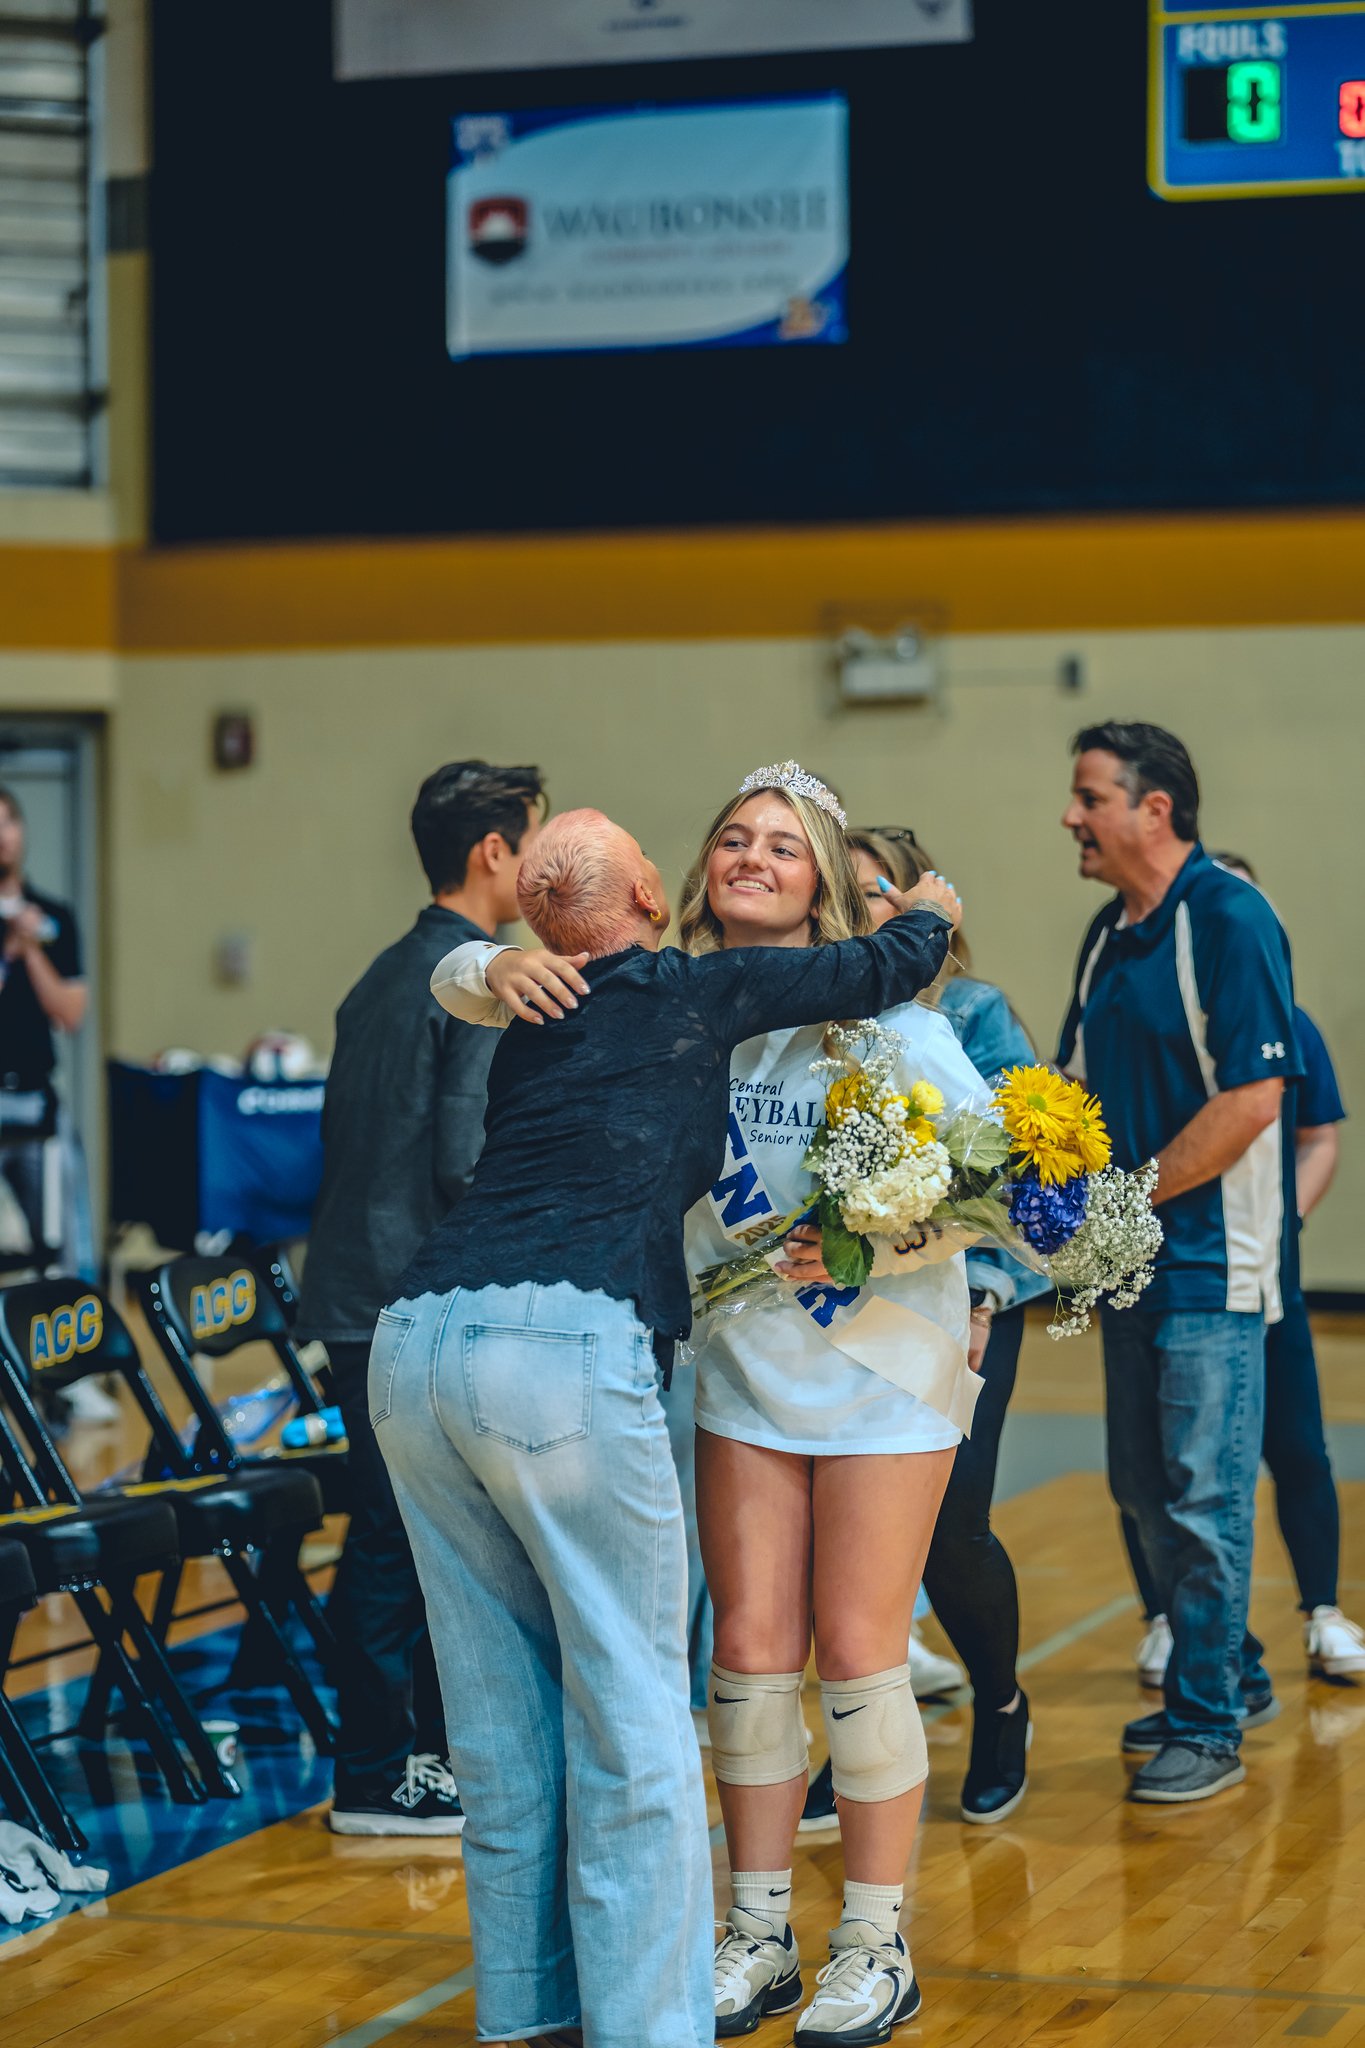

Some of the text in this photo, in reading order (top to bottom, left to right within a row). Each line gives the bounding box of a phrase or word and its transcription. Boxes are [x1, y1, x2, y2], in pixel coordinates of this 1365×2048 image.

[1178, 22, 1287, 61] FOULS
[1227, 61, 1281, 143] 0
[729, 1078, 784, 1096] Central
[735, 1096, 829, 1128] EYBAL
[749, 1129, 794, 1146] Senior
[190, 1268, 256, 1340] ACC
[30, 1294, 103, 1370] ACC
